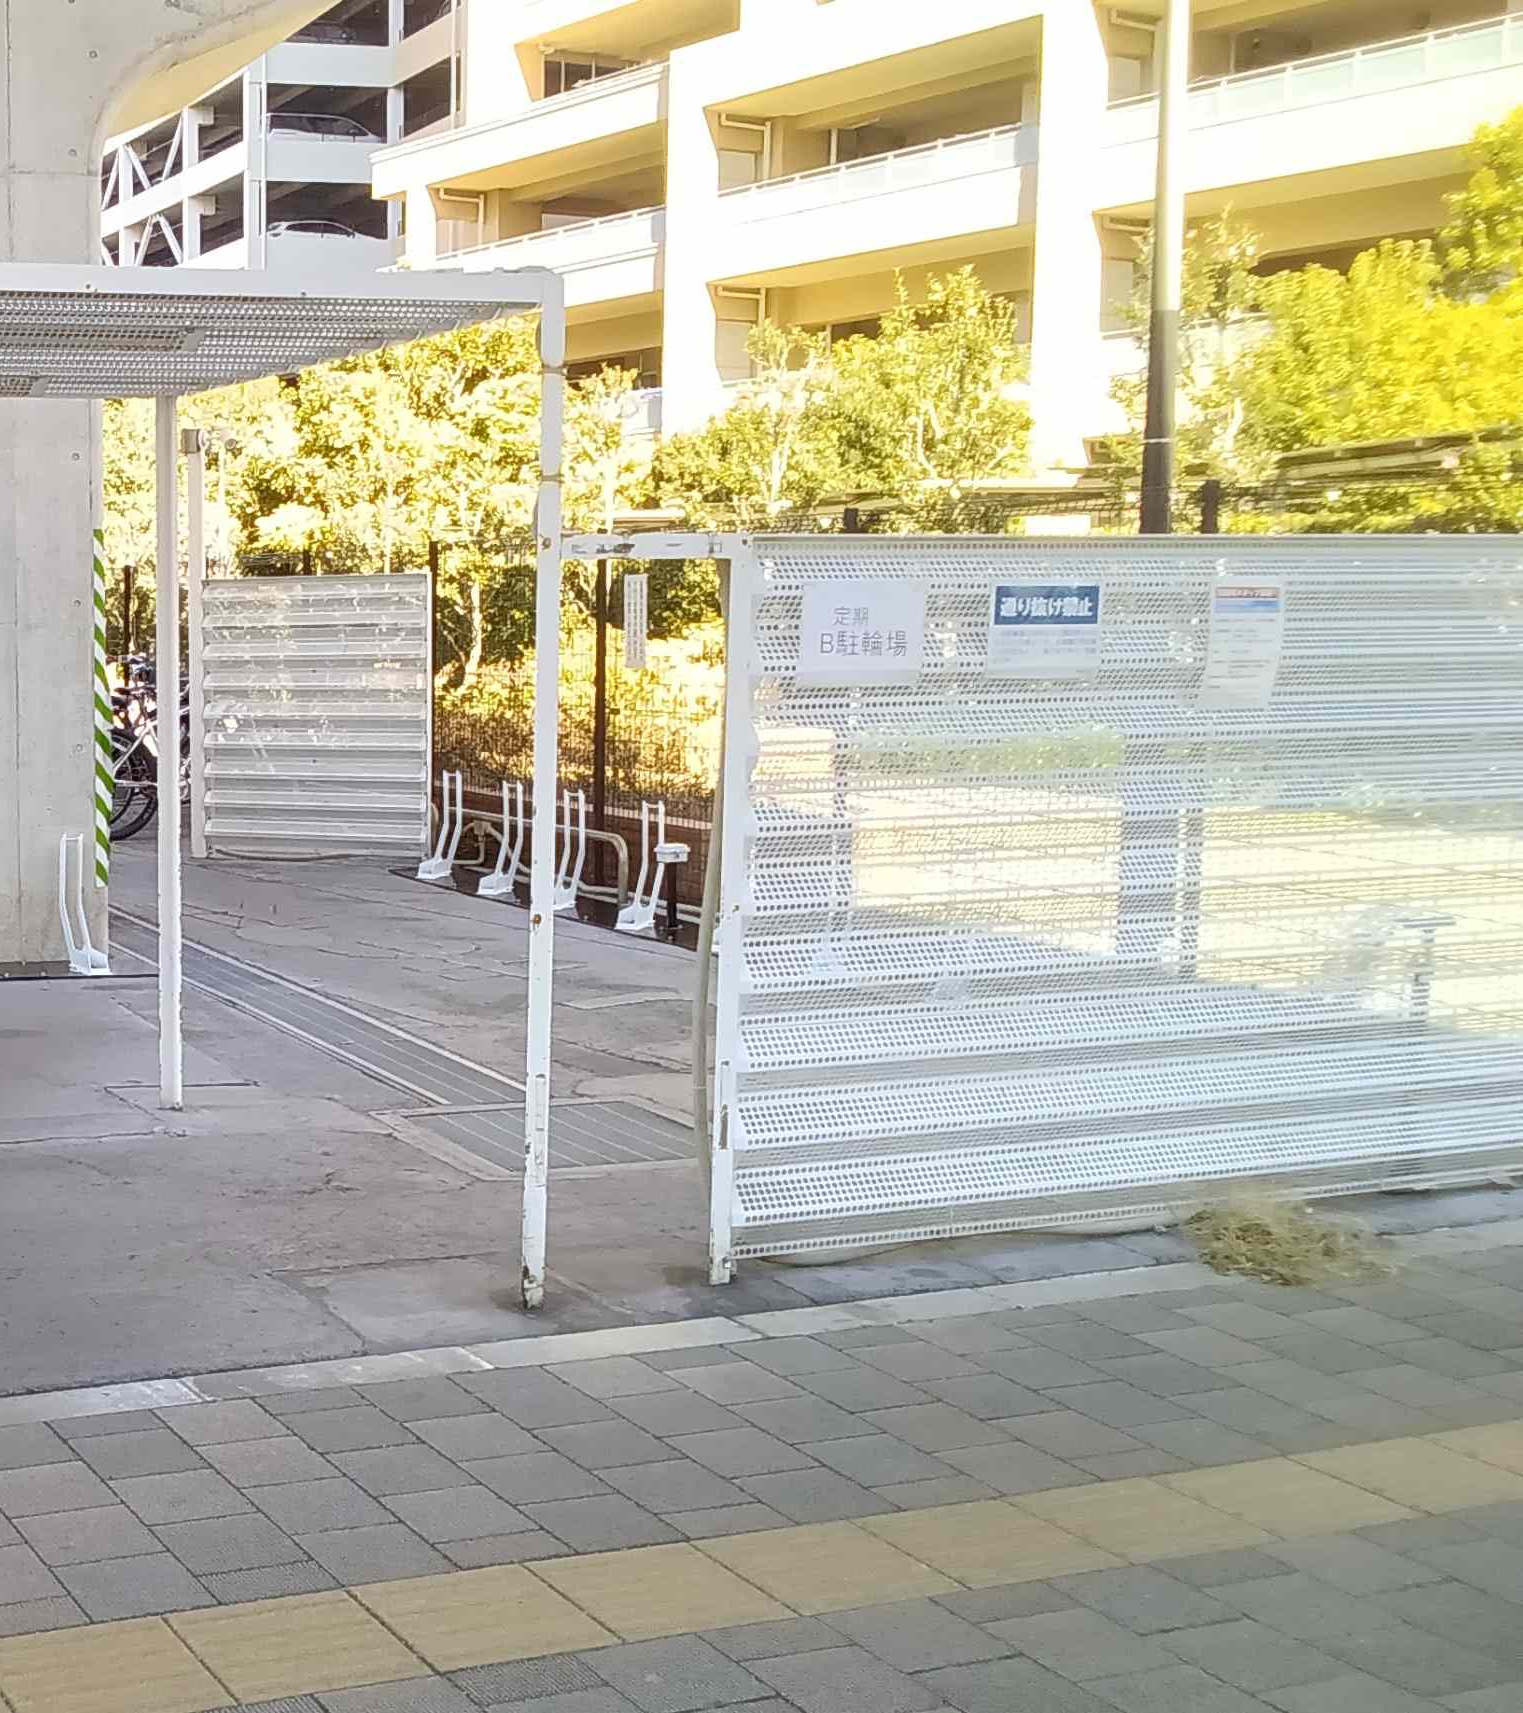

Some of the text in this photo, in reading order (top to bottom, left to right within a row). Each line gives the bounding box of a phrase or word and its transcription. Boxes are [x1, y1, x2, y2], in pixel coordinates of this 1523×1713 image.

[832, 606, 869, 626] 定期
[820, 630, 908, 657] B駐輪場
